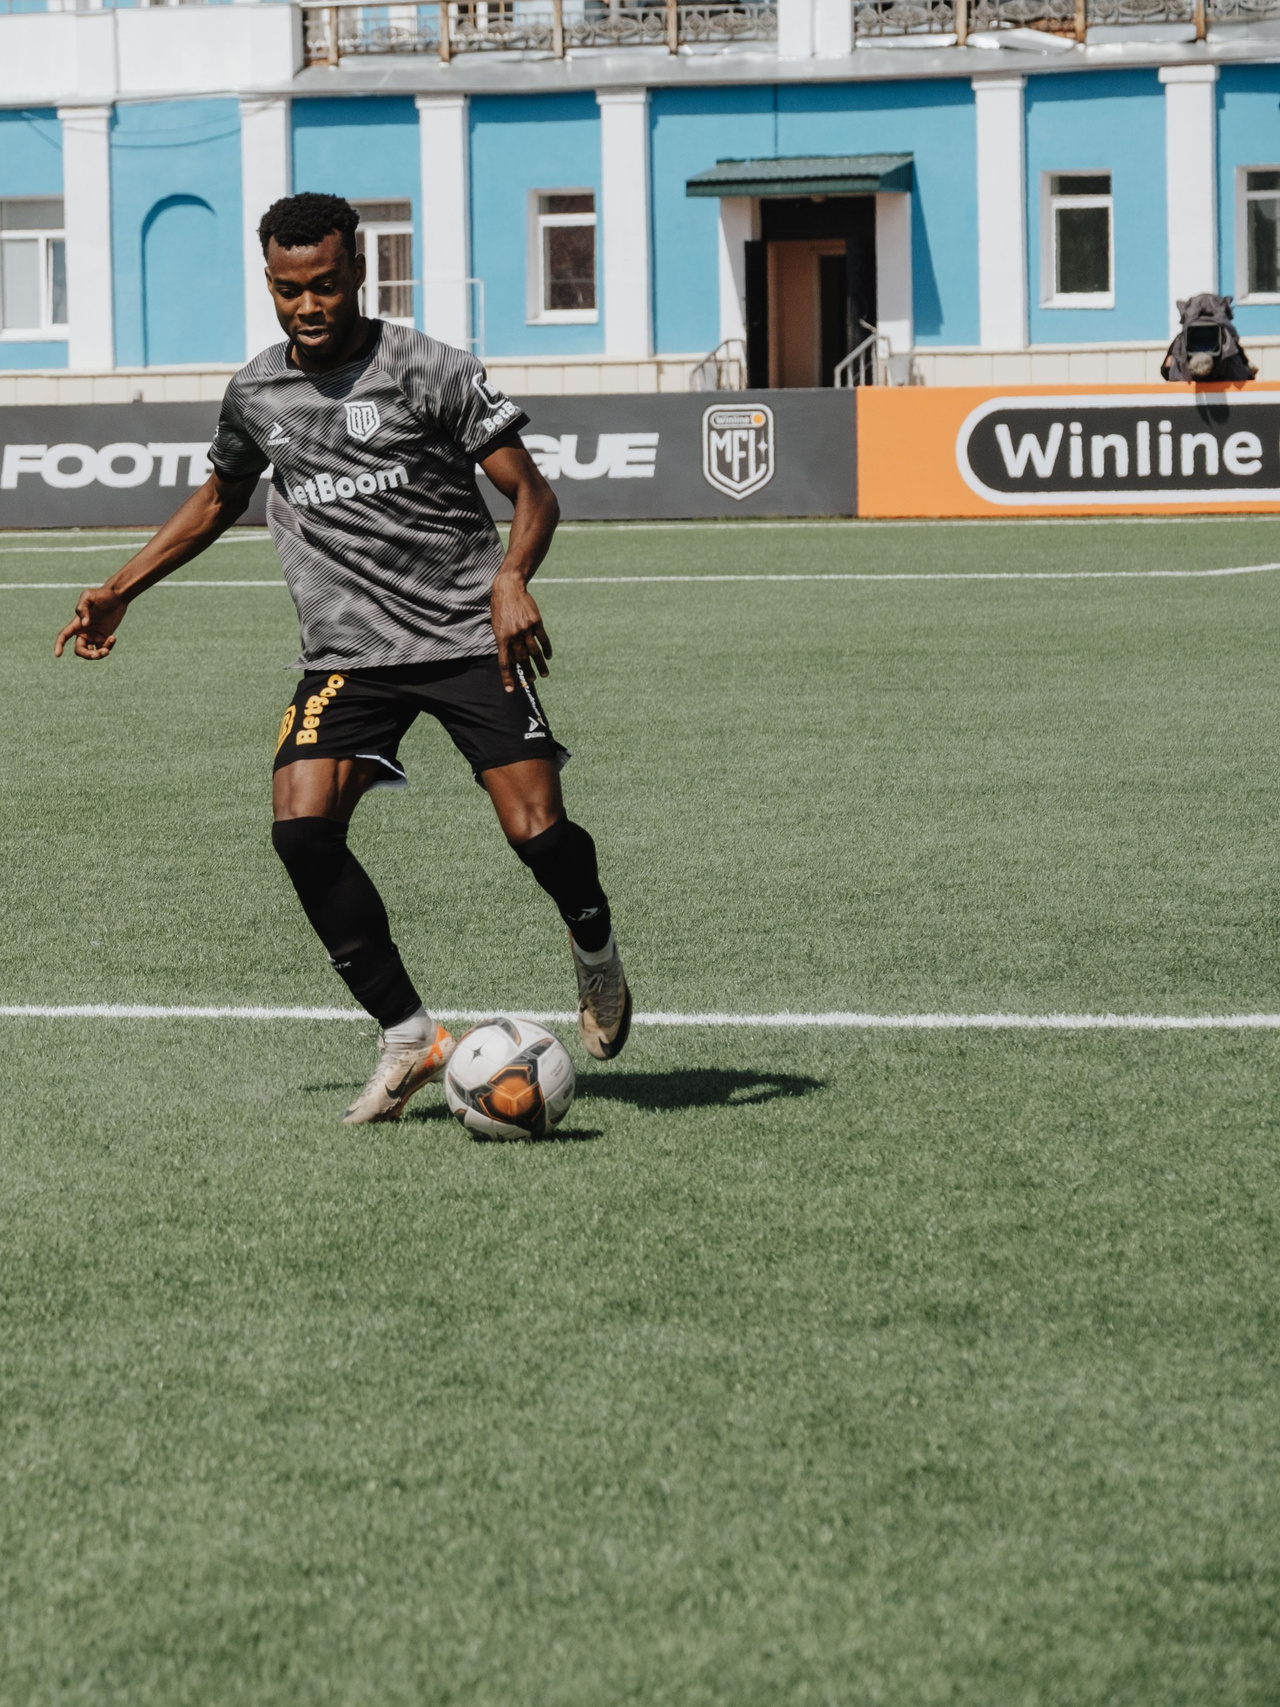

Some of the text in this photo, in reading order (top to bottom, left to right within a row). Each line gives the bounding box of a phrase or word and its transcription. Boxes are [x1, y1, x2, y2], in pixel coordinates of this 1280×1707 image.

[482, 401, 520, 432] BetB
[520, 432, 660, 480] GUE
[710, 429, 767, 492] MFL
[994, 419, 1263, 479] Winline
[283, 465, 410, 506] etBoom
[295, 674, 345, 746] BetBoo
